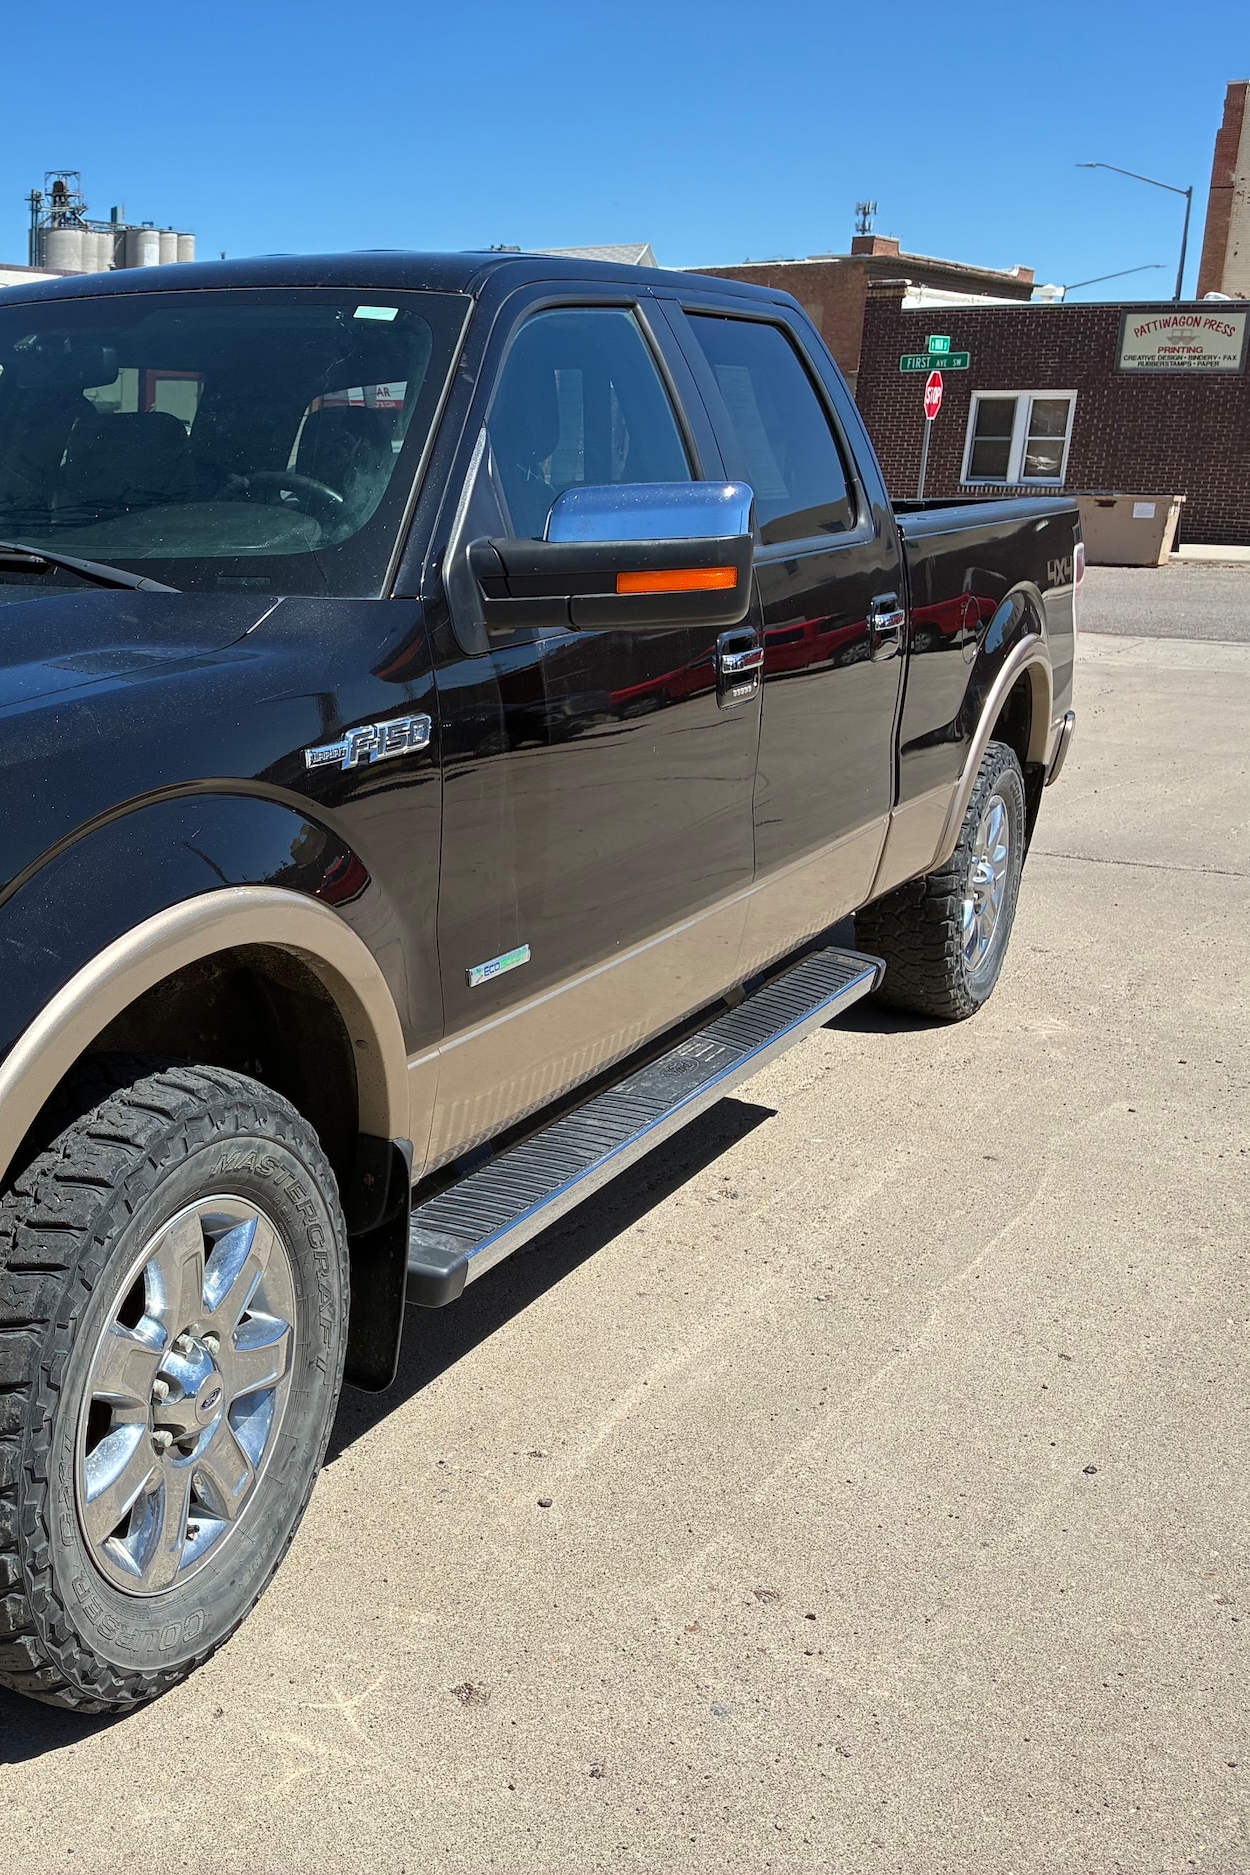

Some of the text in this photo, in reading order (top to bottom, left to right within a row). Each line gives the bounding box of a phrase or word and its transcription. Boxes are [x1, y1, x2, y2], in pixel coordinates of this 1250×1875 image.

[1133, 315, 1236, 338] PATTIWAGON PRESS
[1157, 346, 1204, 354] PRINTING
[907, 357, 962, 369] FIRST AVE SW
[926, 386, 942, 405] STOP
[209, 1149, 337, 1386] MASTERCRAFT
[69, 1573, 206, 1653] COURSER
